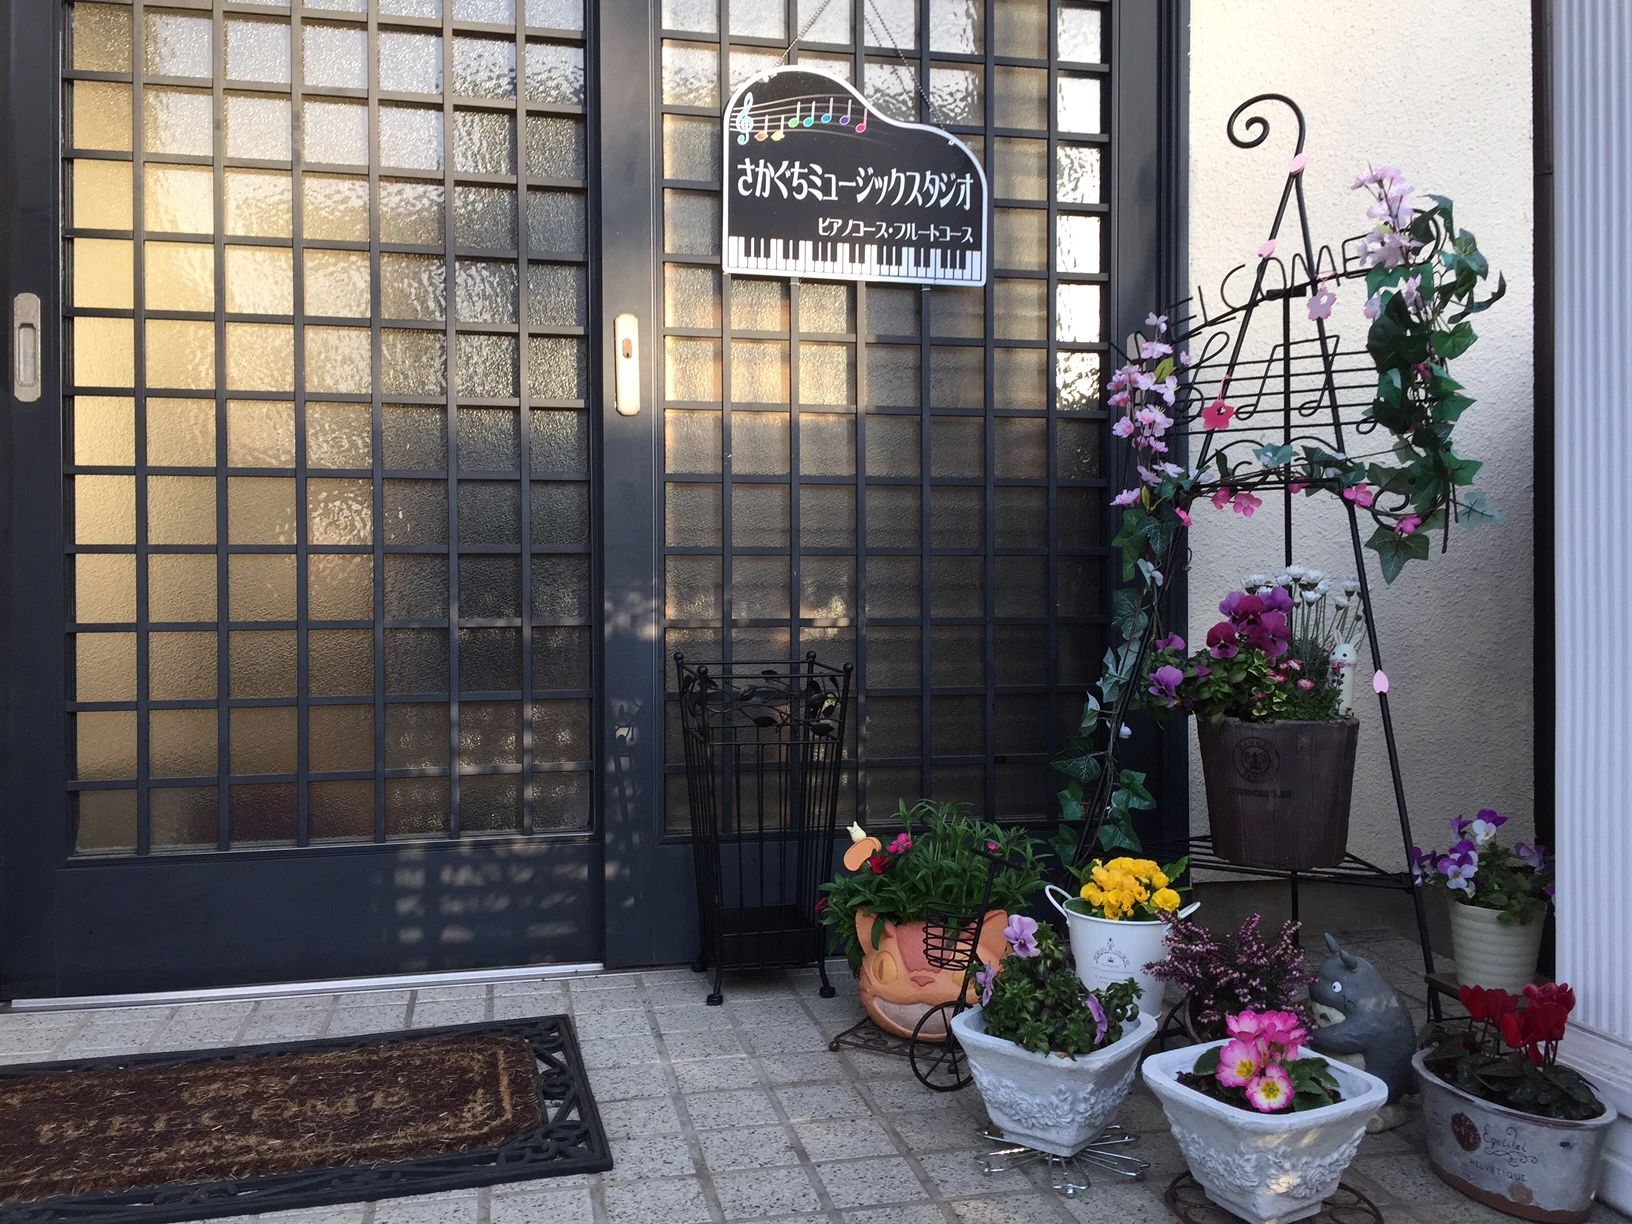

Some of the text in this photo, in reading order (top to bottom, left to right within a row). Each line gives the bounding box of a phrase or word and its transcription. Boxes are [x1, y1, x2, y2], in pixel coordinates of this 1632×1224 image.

[737, 157, 974, 211] さかぐちミュージックスタジオ
